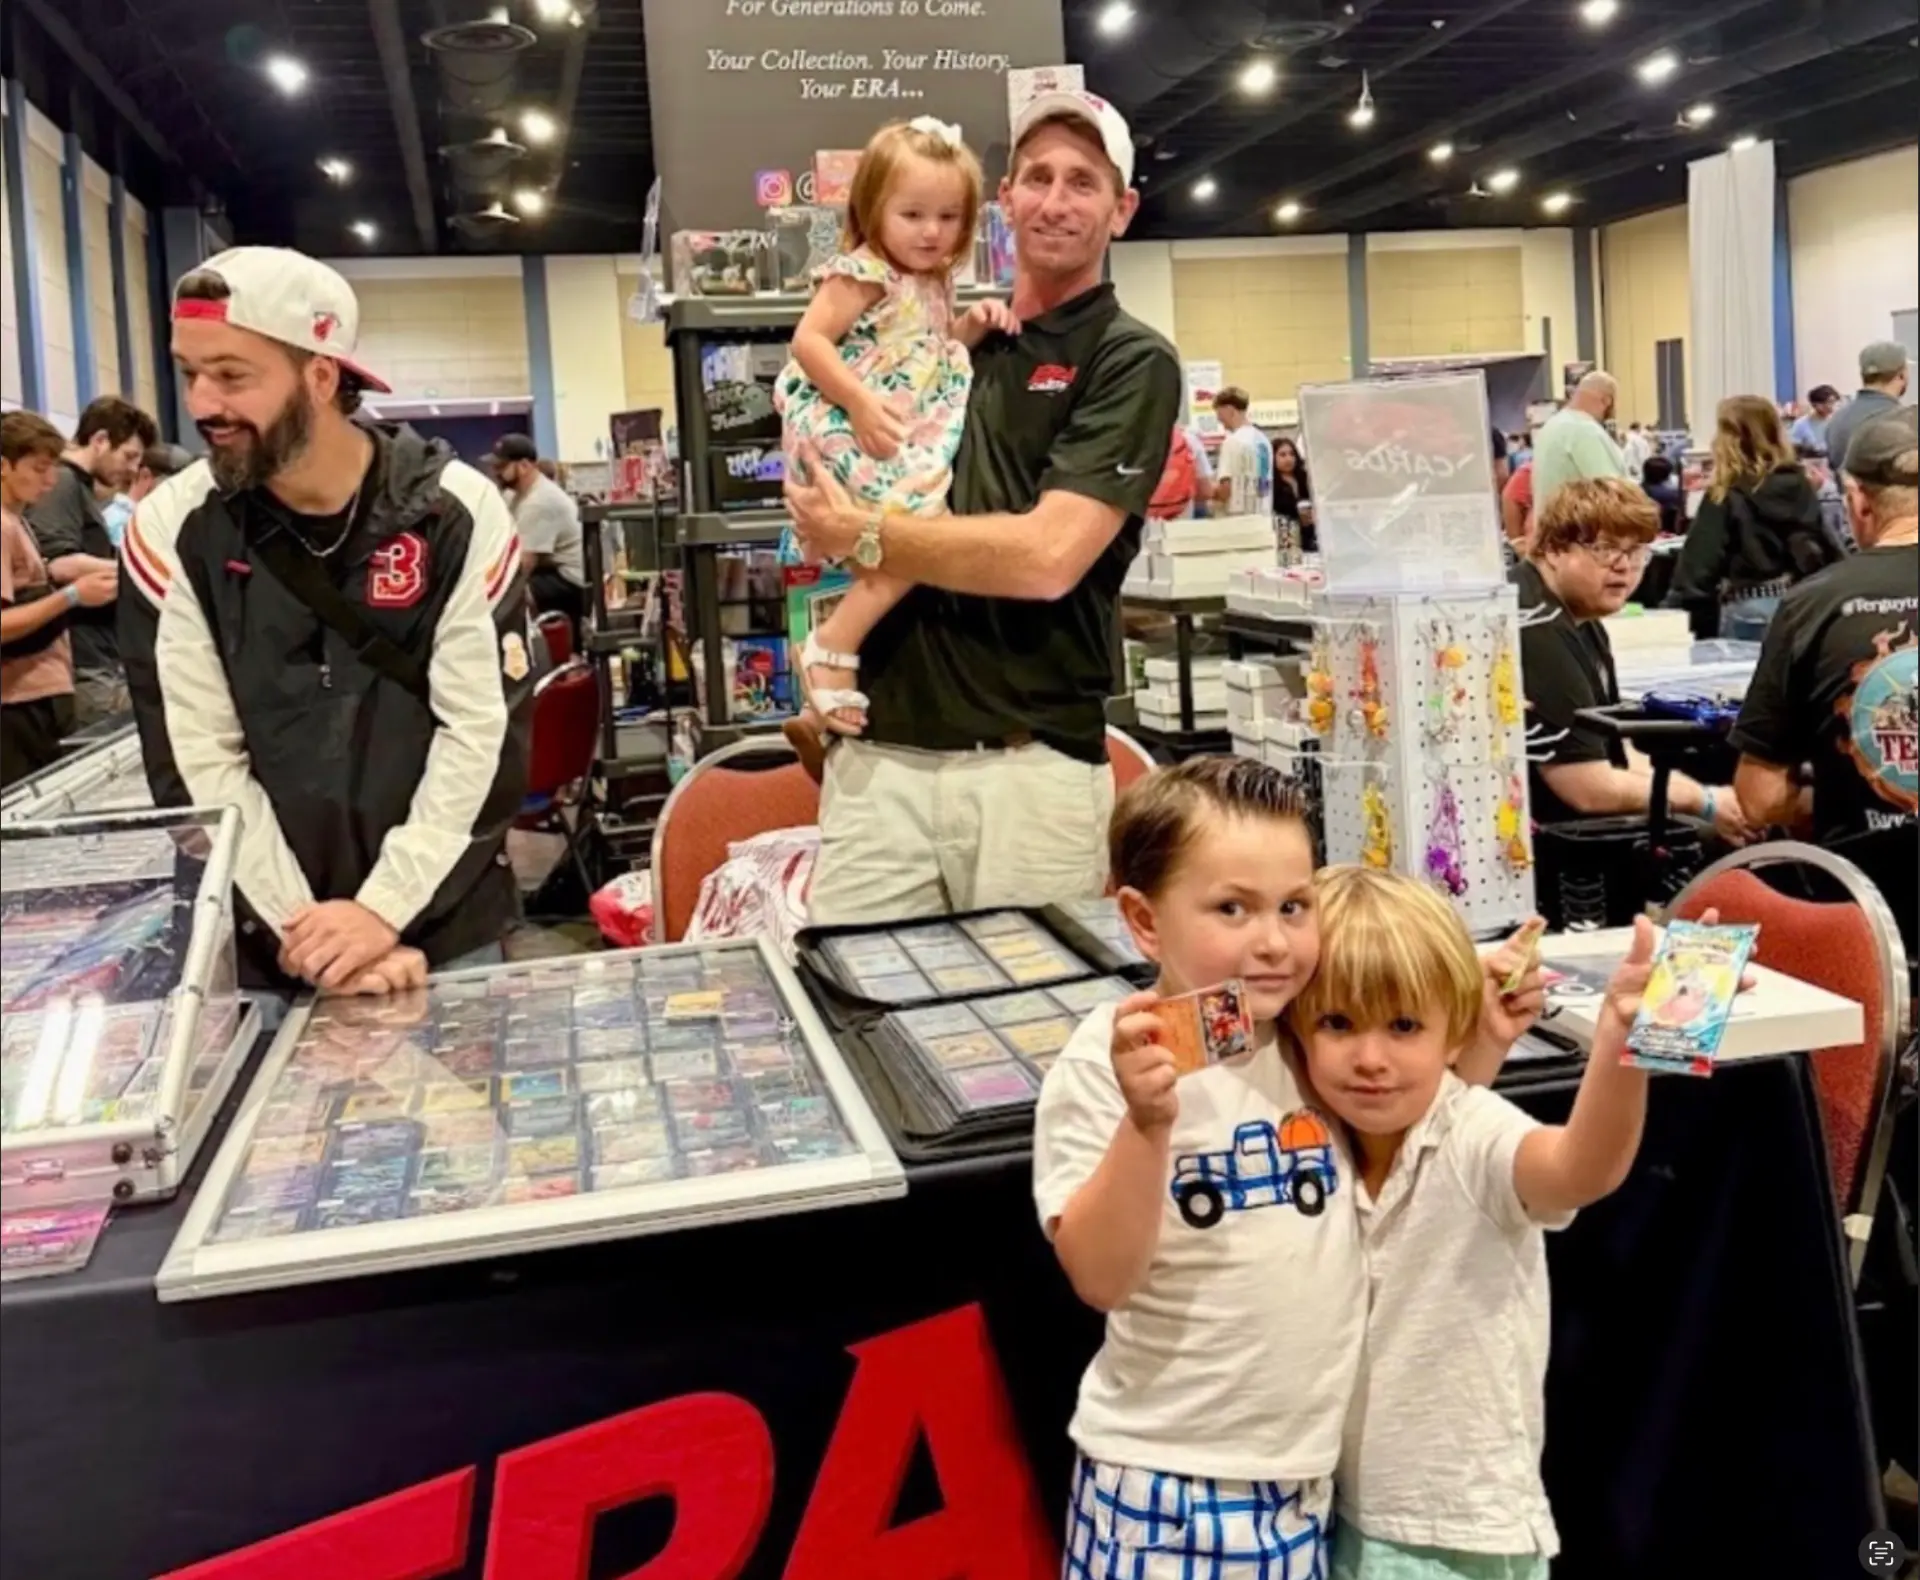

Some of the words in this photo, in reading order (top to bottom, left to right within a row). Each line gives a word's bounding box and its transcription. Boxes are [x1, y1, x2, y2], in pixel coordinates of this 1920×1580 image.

[726, 0, 765, 15] For
[771, 0, 894, 16] Generations
[899, 0, 919, 16] to
[925, 0, 986, 16] Come.
[706, 49, 755, 70] Your
[760, 49, 874, 70] Collection.
[882, 49, 928, 70] Your
[933, 49, 1011, 75] History.
[801, 78, 846, 98] Your
[851, 77, 924, 98] ERA...
[368, 532, 429, 607] 3
